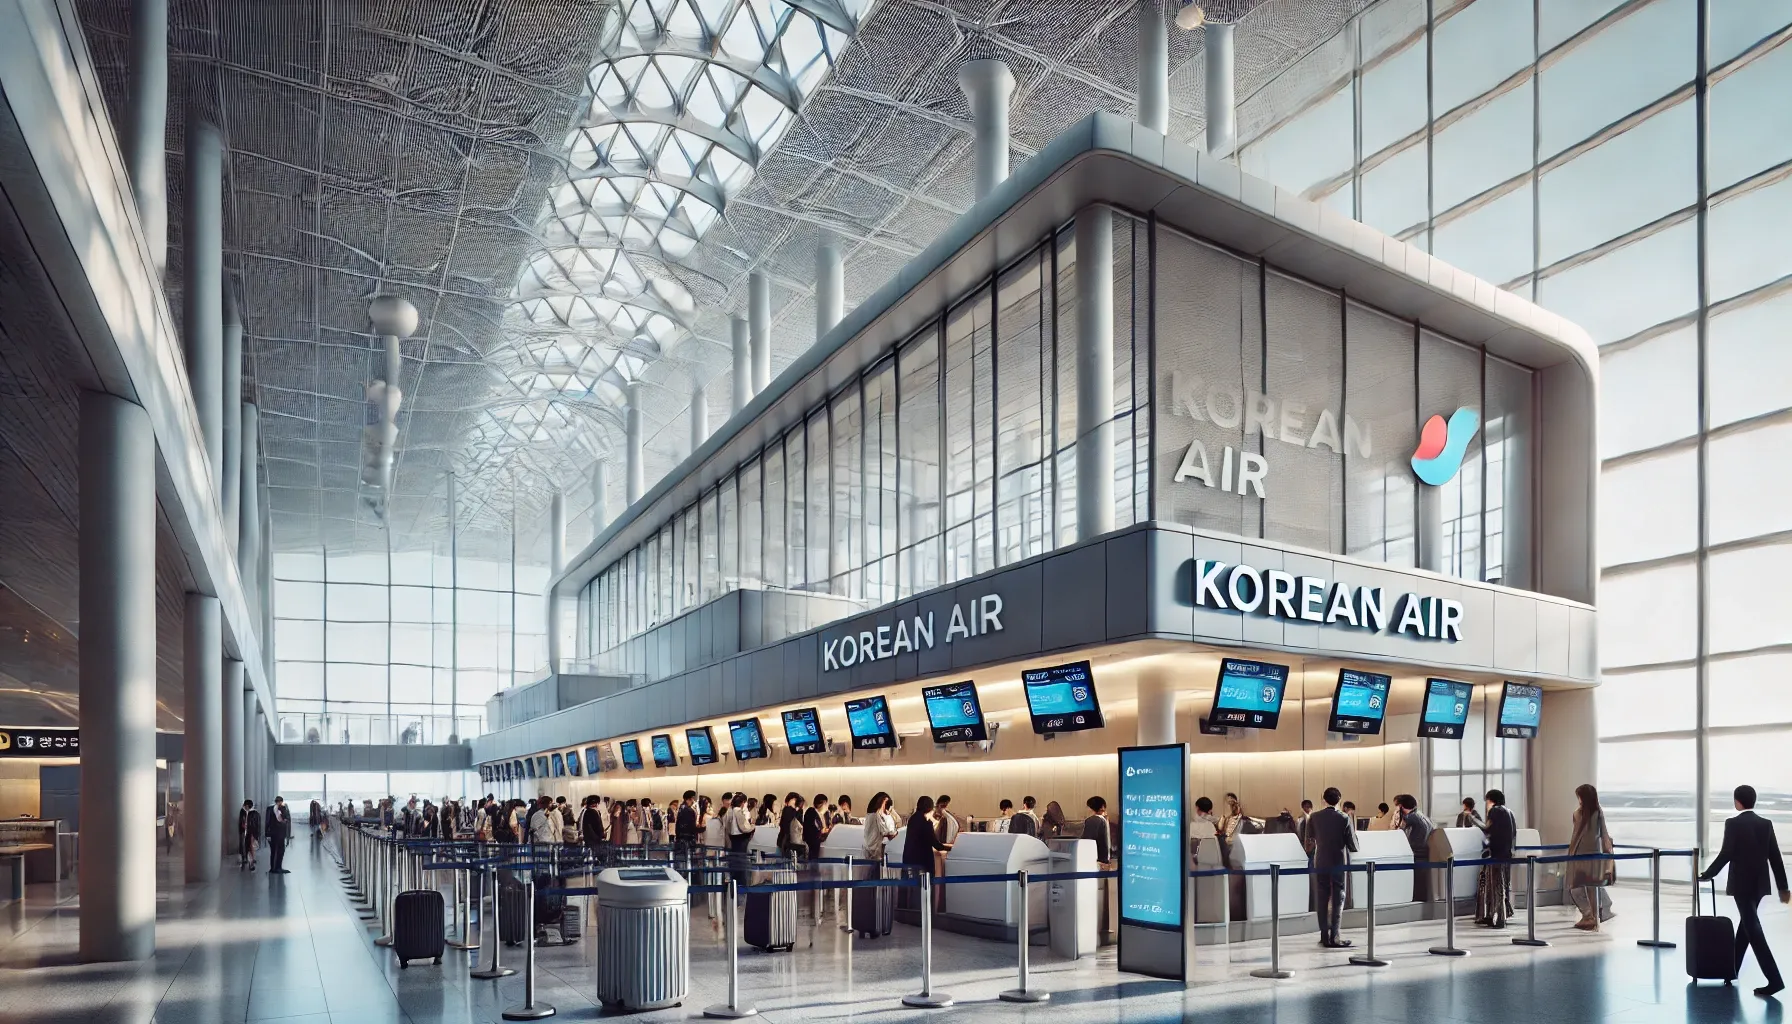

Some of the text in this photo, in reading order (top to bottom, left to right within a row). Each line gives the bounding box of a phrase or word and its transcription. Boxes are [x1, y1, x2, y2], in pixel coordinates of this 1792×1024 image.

[1171, 371, 1372, 460] KOREAN
[1174, 439, 1269, 499] AIR
[823, 593, 1004, 672] KOREAN AIR
[1194, 558, 1465, 641] KOREAN AIR
